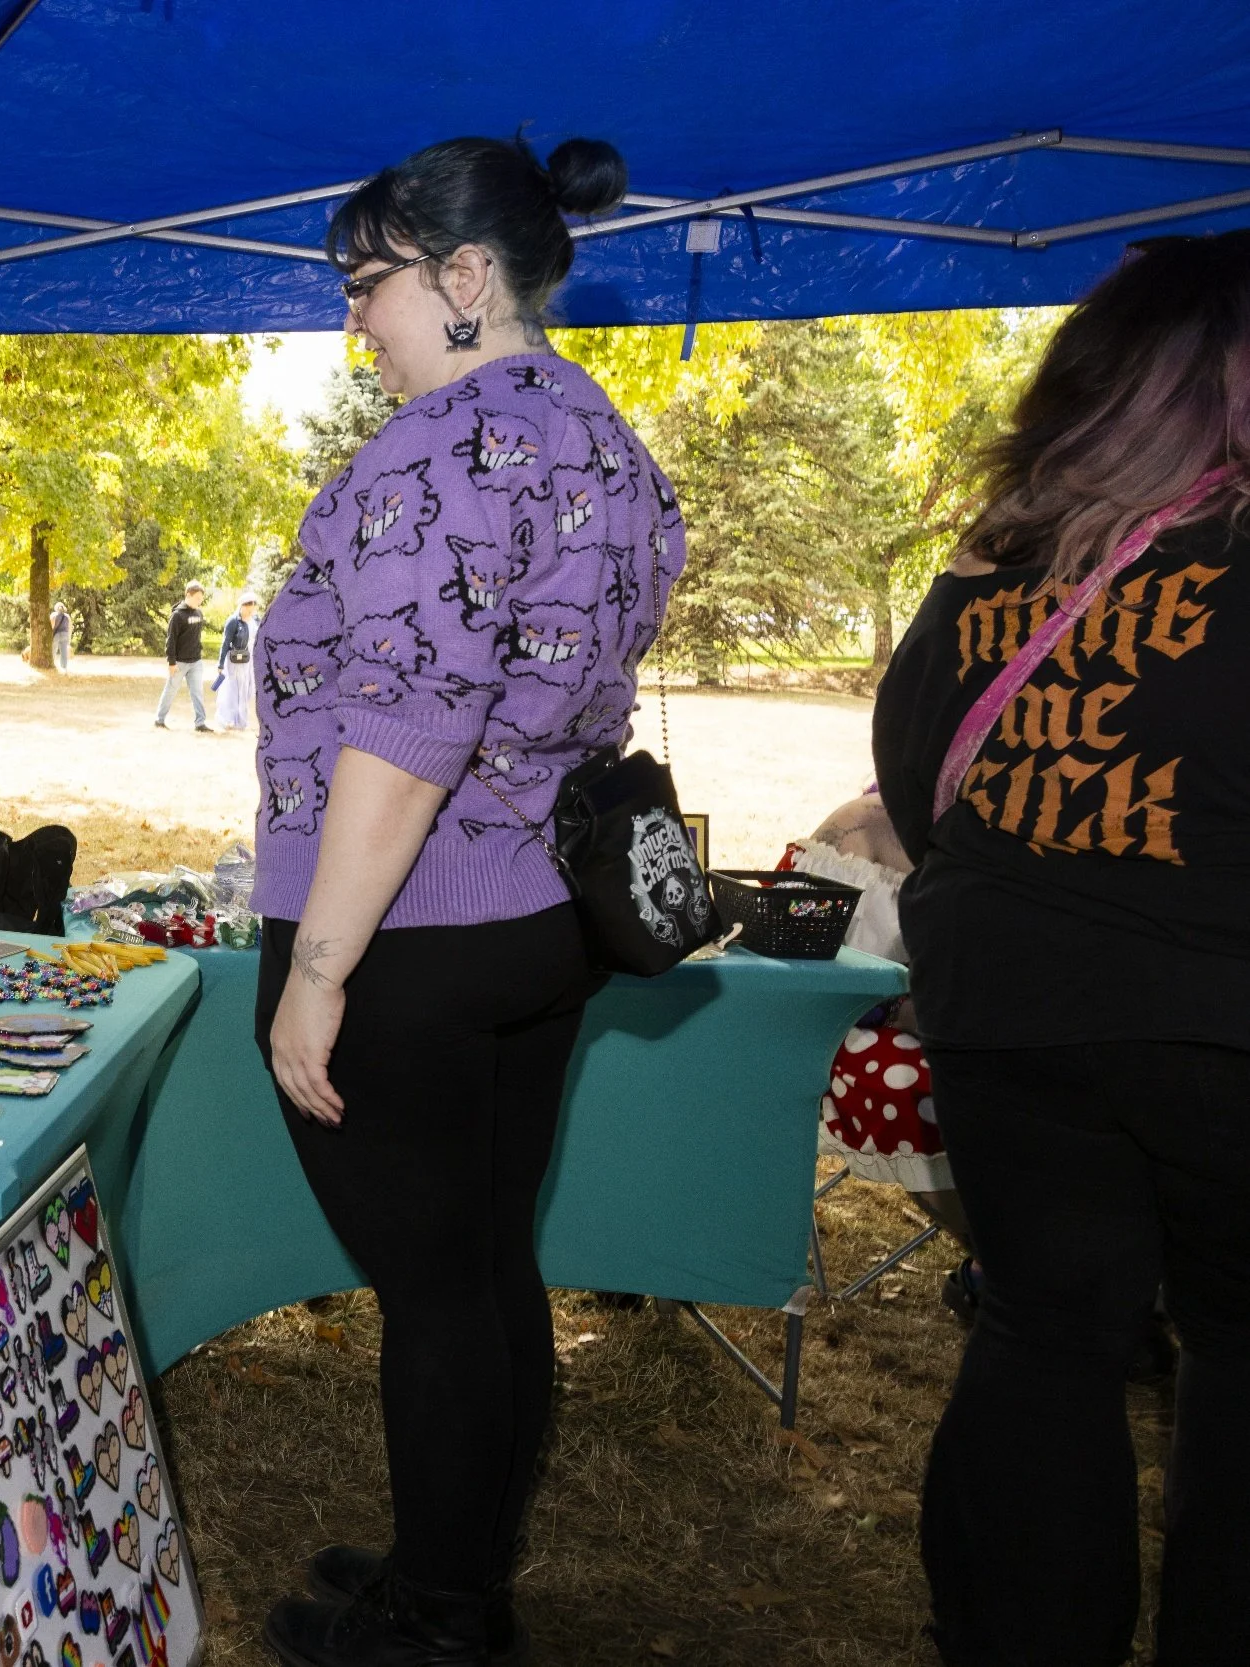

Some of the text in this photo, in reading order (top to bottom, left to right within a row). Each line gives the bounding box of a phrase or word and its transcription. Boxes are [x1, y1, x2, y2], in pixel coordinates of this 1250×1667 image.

[956, 562, 1231, 684] MAKE
[996, 682, 1140, 750] me
[960, 752, 1187, 866] SICK
